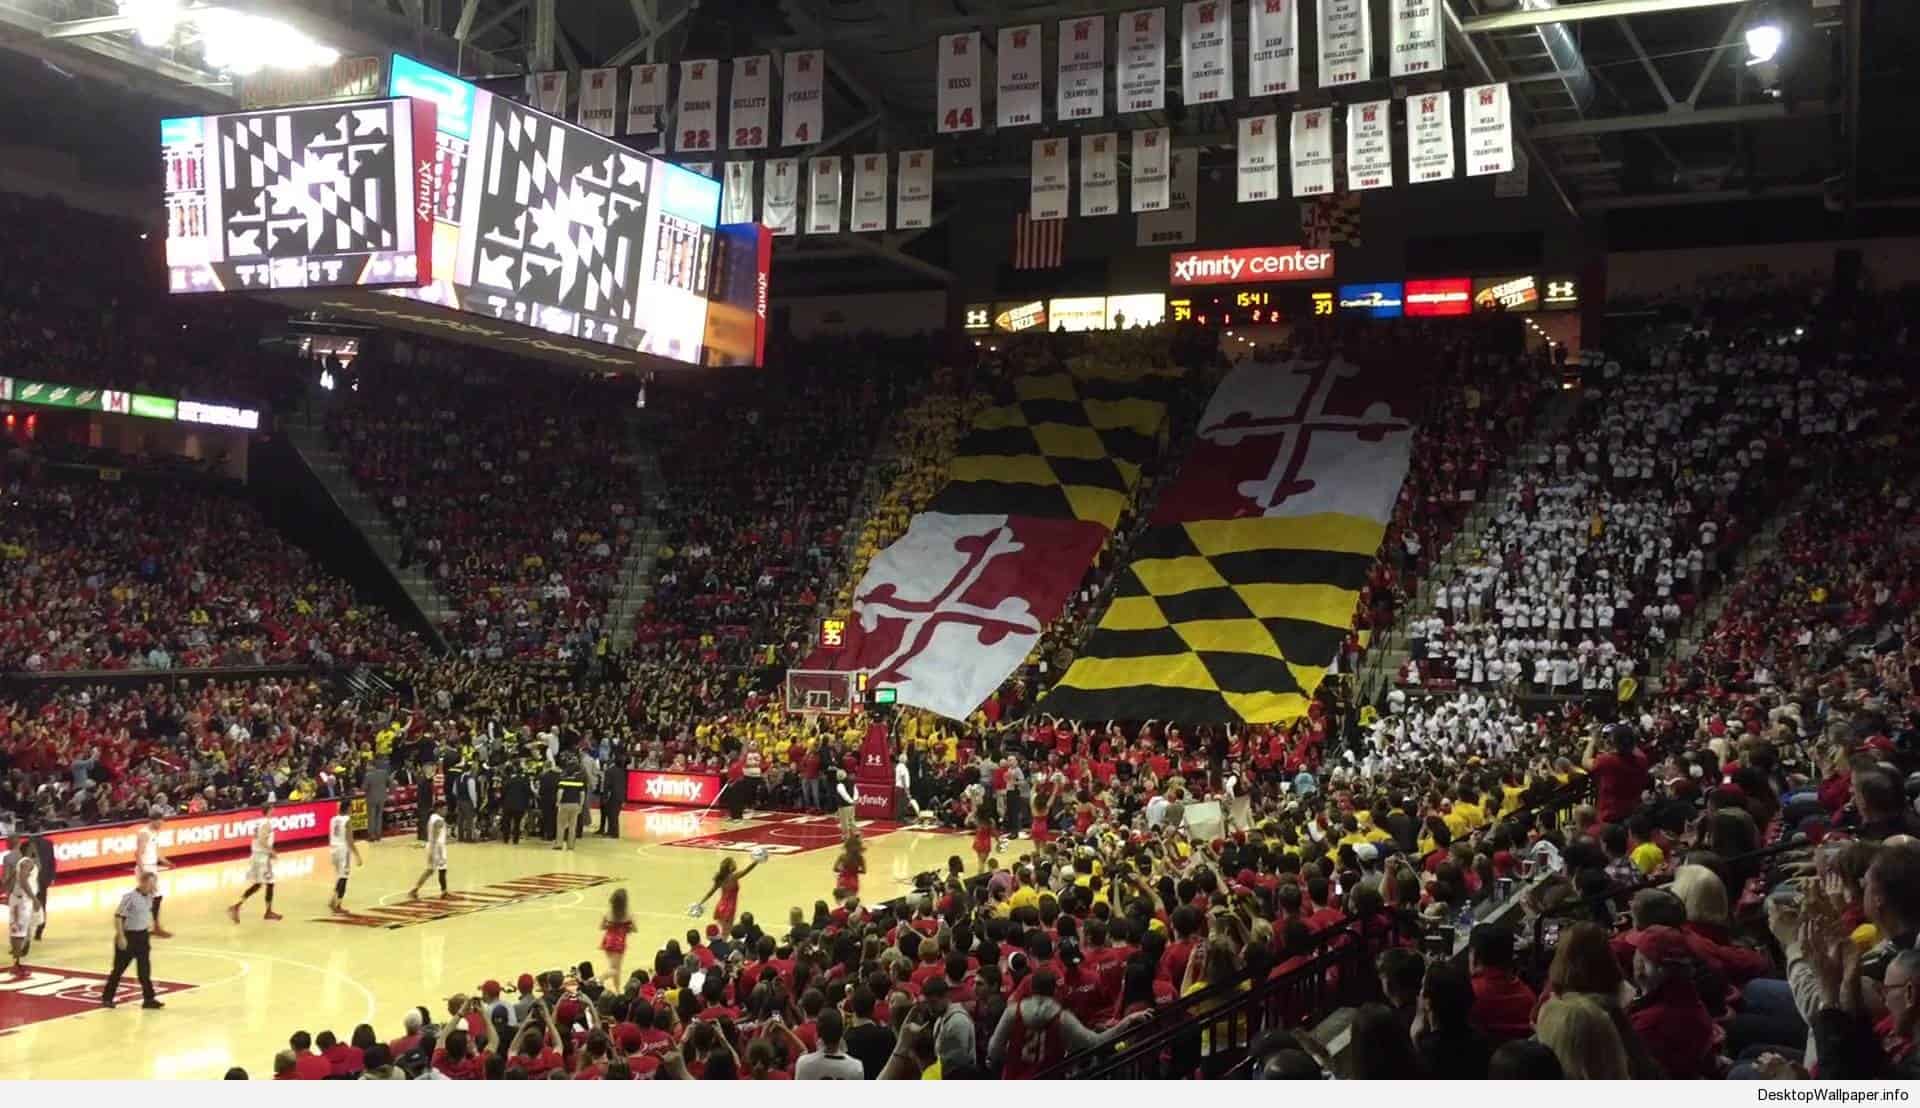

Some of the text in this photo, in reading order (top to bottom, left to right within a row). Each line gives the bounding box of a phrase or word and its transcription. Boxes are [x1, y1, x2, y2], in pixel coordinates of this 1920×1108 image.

[944, 107, 973, 128] 44
[684, 130, 710, 148] 22
[736, 126, 762, 146] 23
[795, 122, 808, 141] 4
[417, 160, 432, 221] xfinity
[1175, 250, 1330, 281] xfinity center
[1175, 308, 1191, 321] 34
[645, 775, 703, 800] xfinity
[177, 823, 222, 846] MOST
